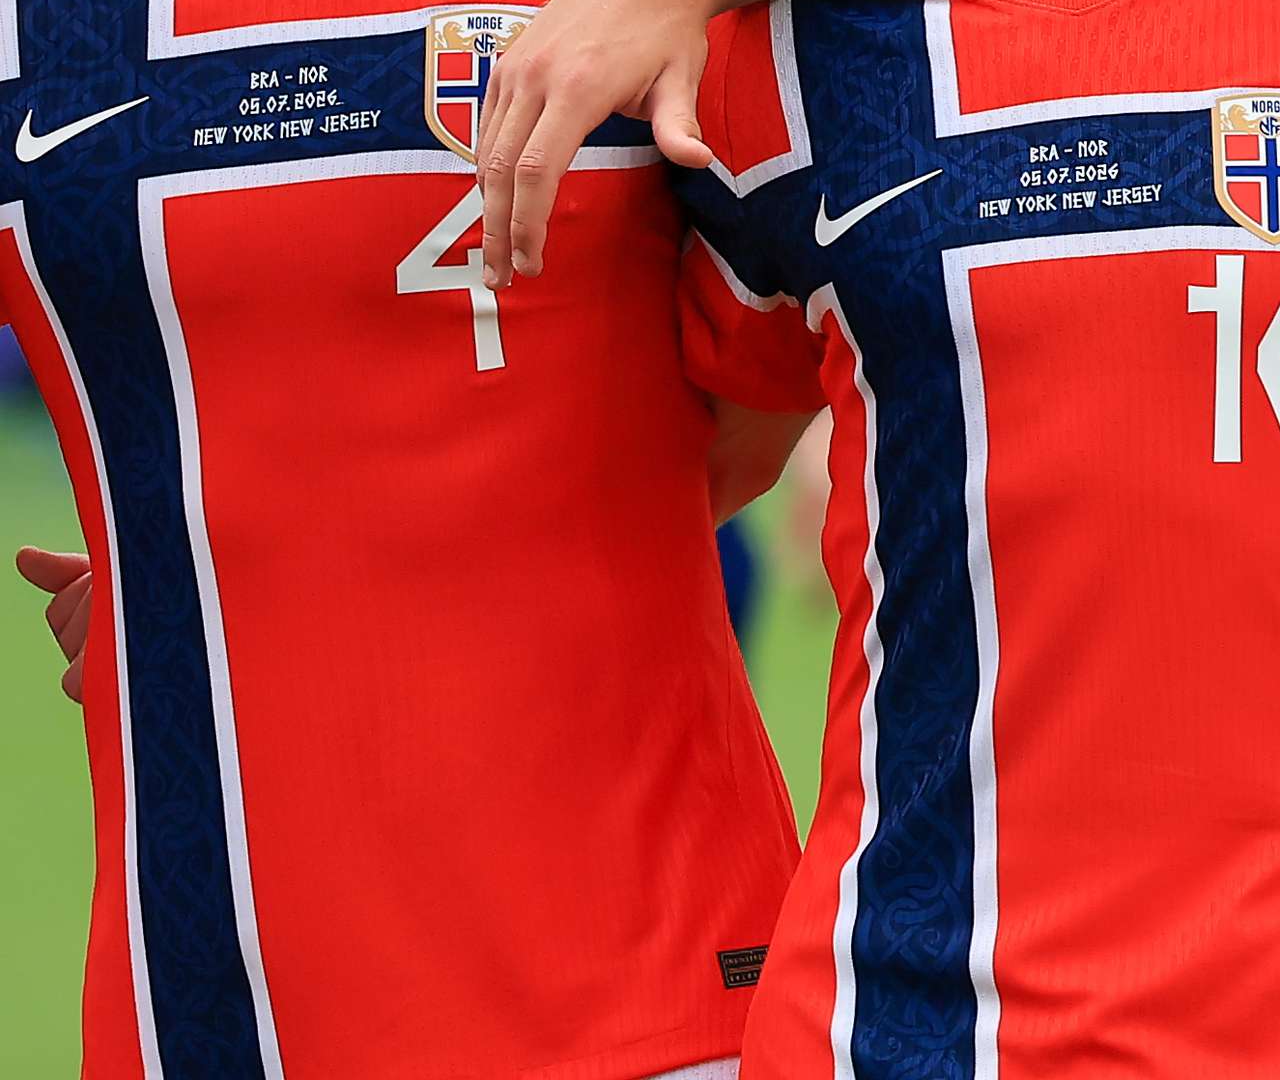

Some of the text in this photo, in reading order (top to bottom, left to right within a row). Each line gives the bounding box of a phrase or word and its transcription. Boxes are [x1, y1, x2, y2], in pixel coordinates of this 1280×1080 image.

[467, 16, 503, 30] NORGE
[250, 70, 280, 90] BRA
[299, 65, 329, 85] NOR
[238, 89, 338, 116] 05.07.2026
[193, 109, 381, 147] NEW YORK NEW JERSEY
[1030, 144, 1059, 164] BRA
[1078, 139, 1109, 158] NOR
[1020, 163, 1119, 187] 05.07.2026
[979, 184, 1162, 219] NEW YORK NEW JERSEY
[395, 182, 512, 372] 4
